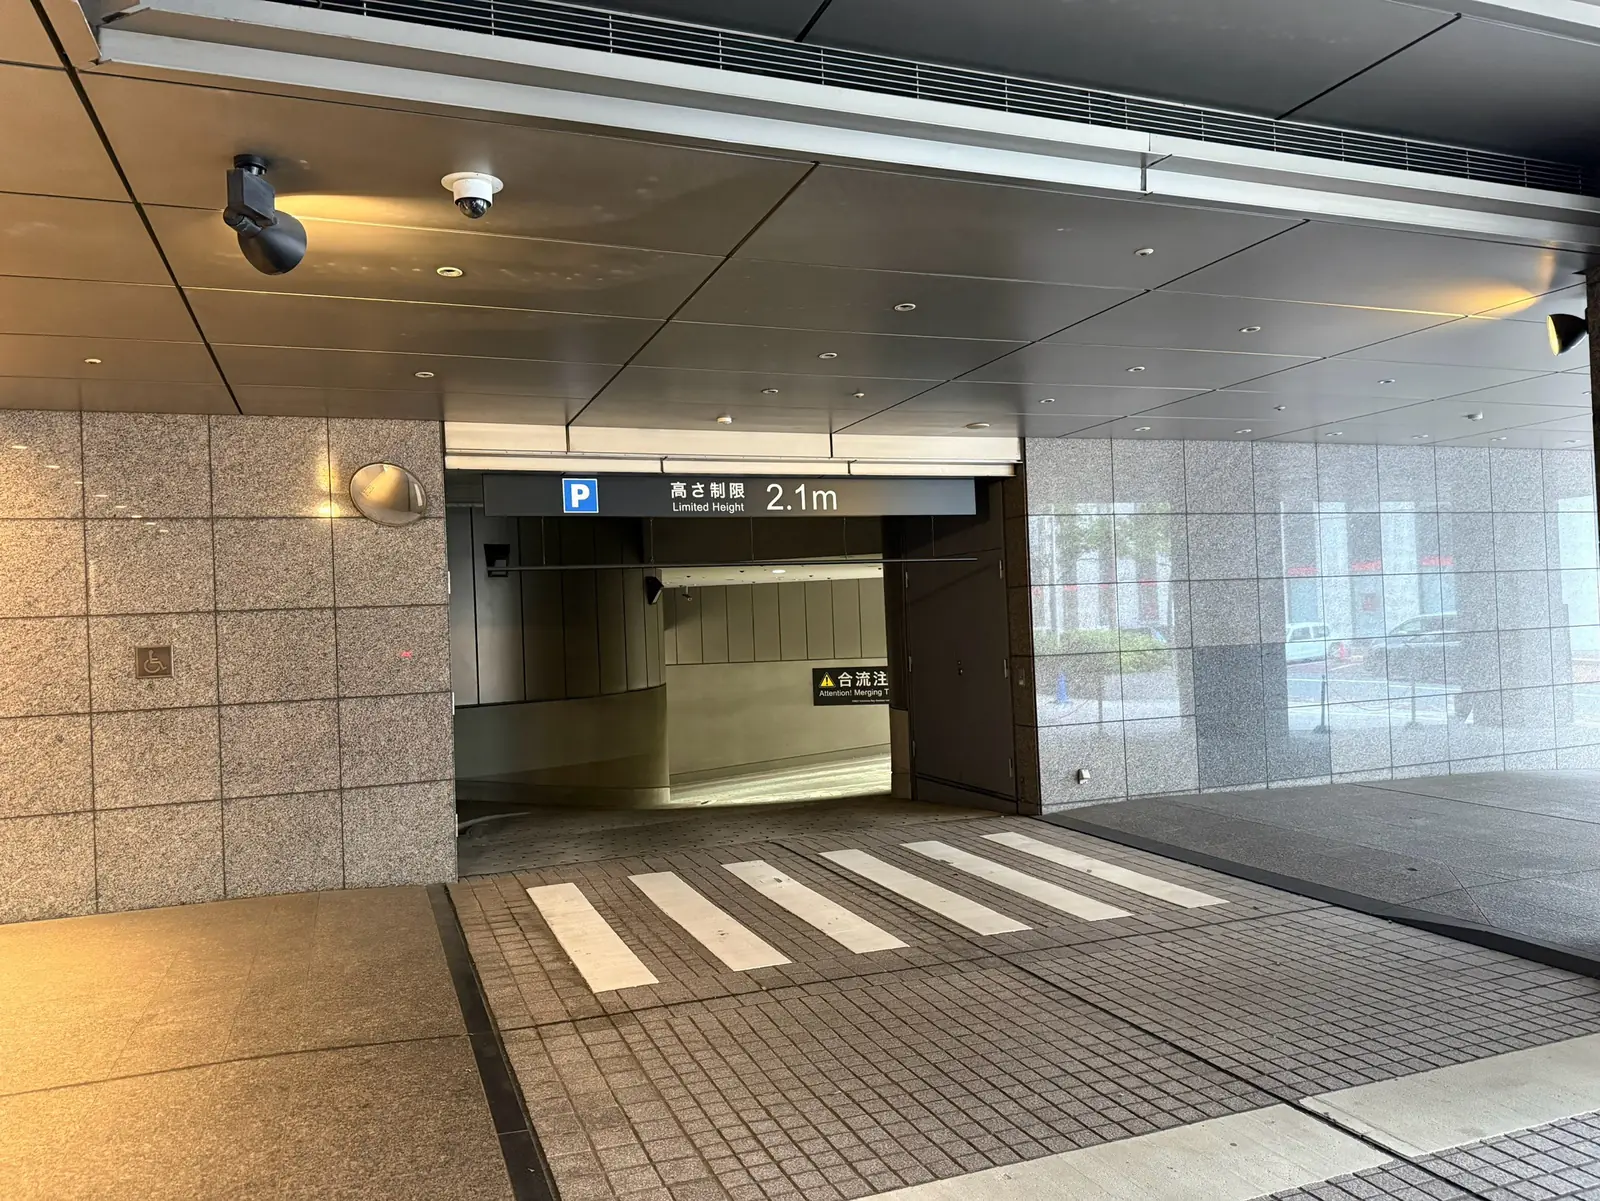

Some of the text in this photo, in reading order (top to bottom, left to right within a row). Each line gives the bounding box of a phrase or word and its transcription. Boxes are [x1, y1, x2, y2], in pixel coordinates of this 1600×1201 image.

[570, 483, 590, 508] P
[670, 481, 746, 499] 高さ制限
[766, 483, 838, 511] 2.1m
[672, 501, 745, 514] Limited Height
[838, 671, 889, 688] 合流注
[819, 689, 852, 697] Attention!
[854, 688, 882, 697] Merging
